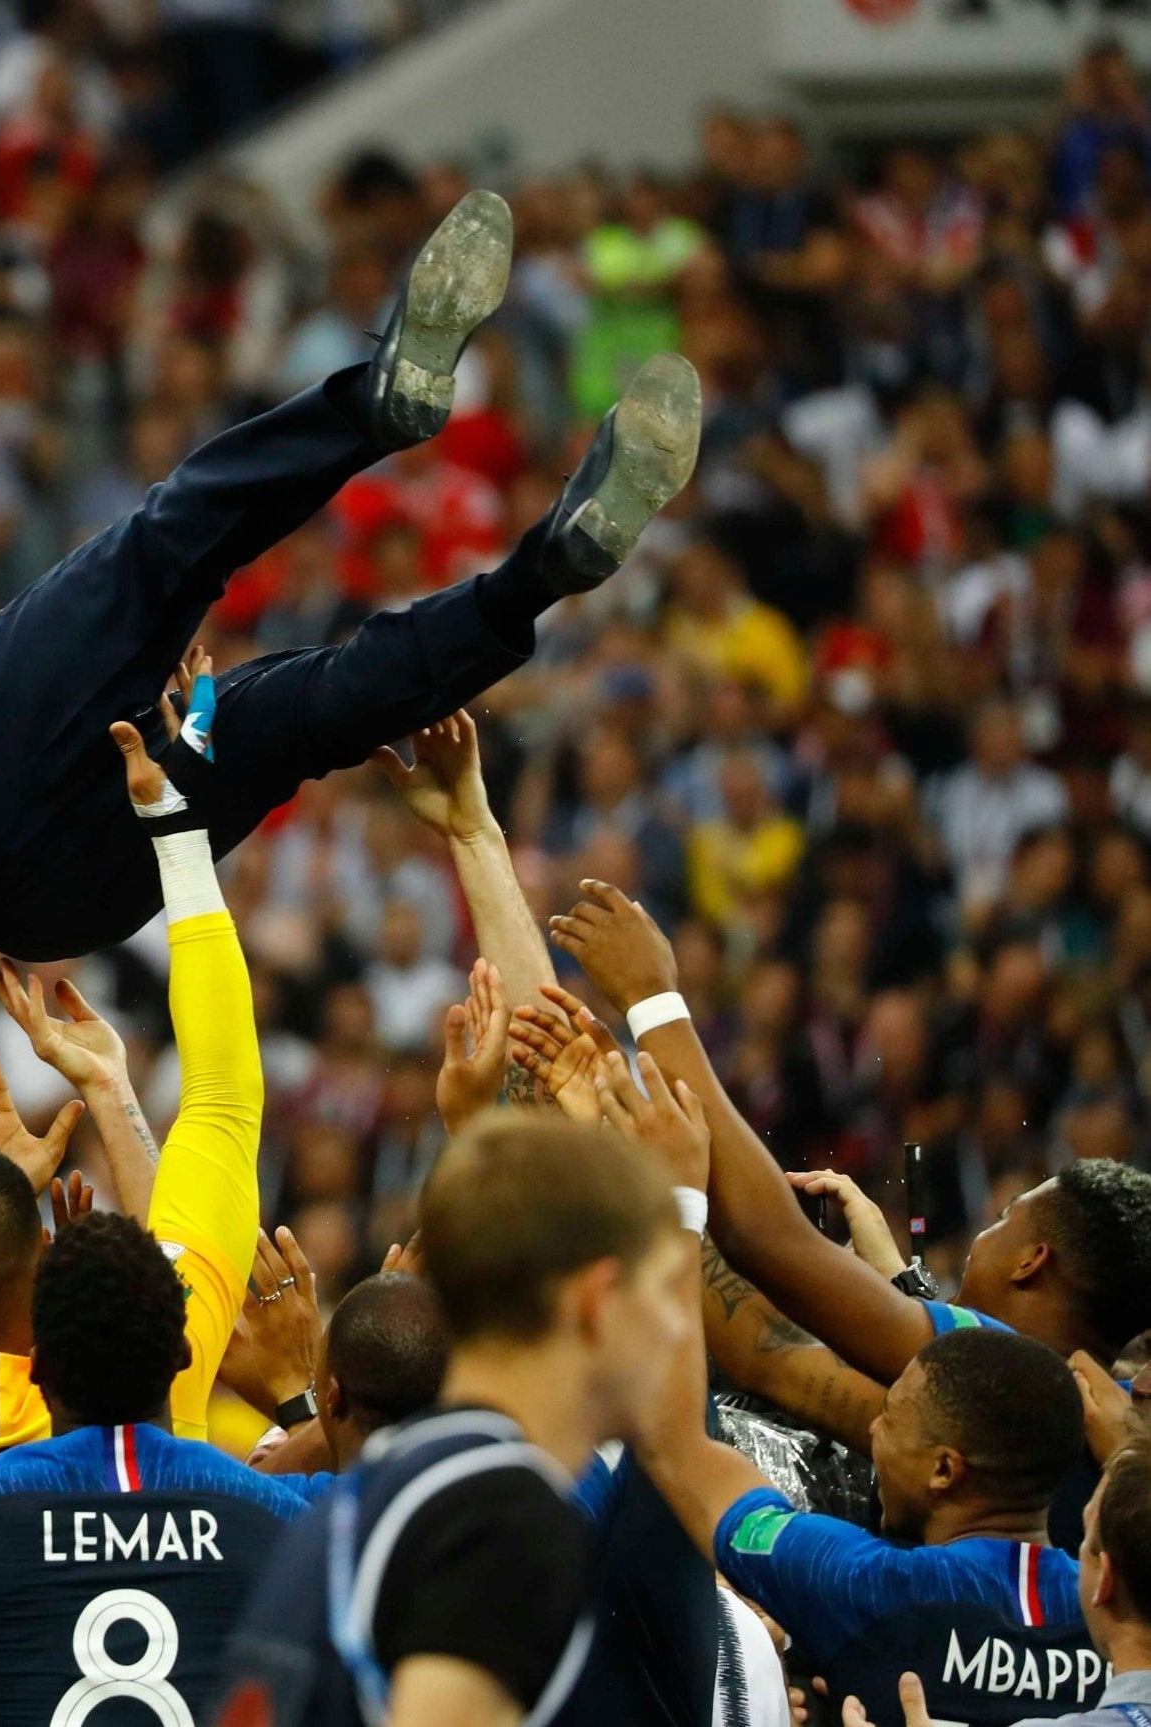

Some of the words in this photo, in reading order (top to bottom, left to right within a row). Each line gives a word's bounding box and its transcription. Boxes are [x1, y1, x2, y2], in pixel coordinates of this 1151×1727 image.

[43, 1509, 224, 1562] LEMAR
[49, 1588, 196, 1727] 8
[943, 1628, 1114, 1703] MBAPP
